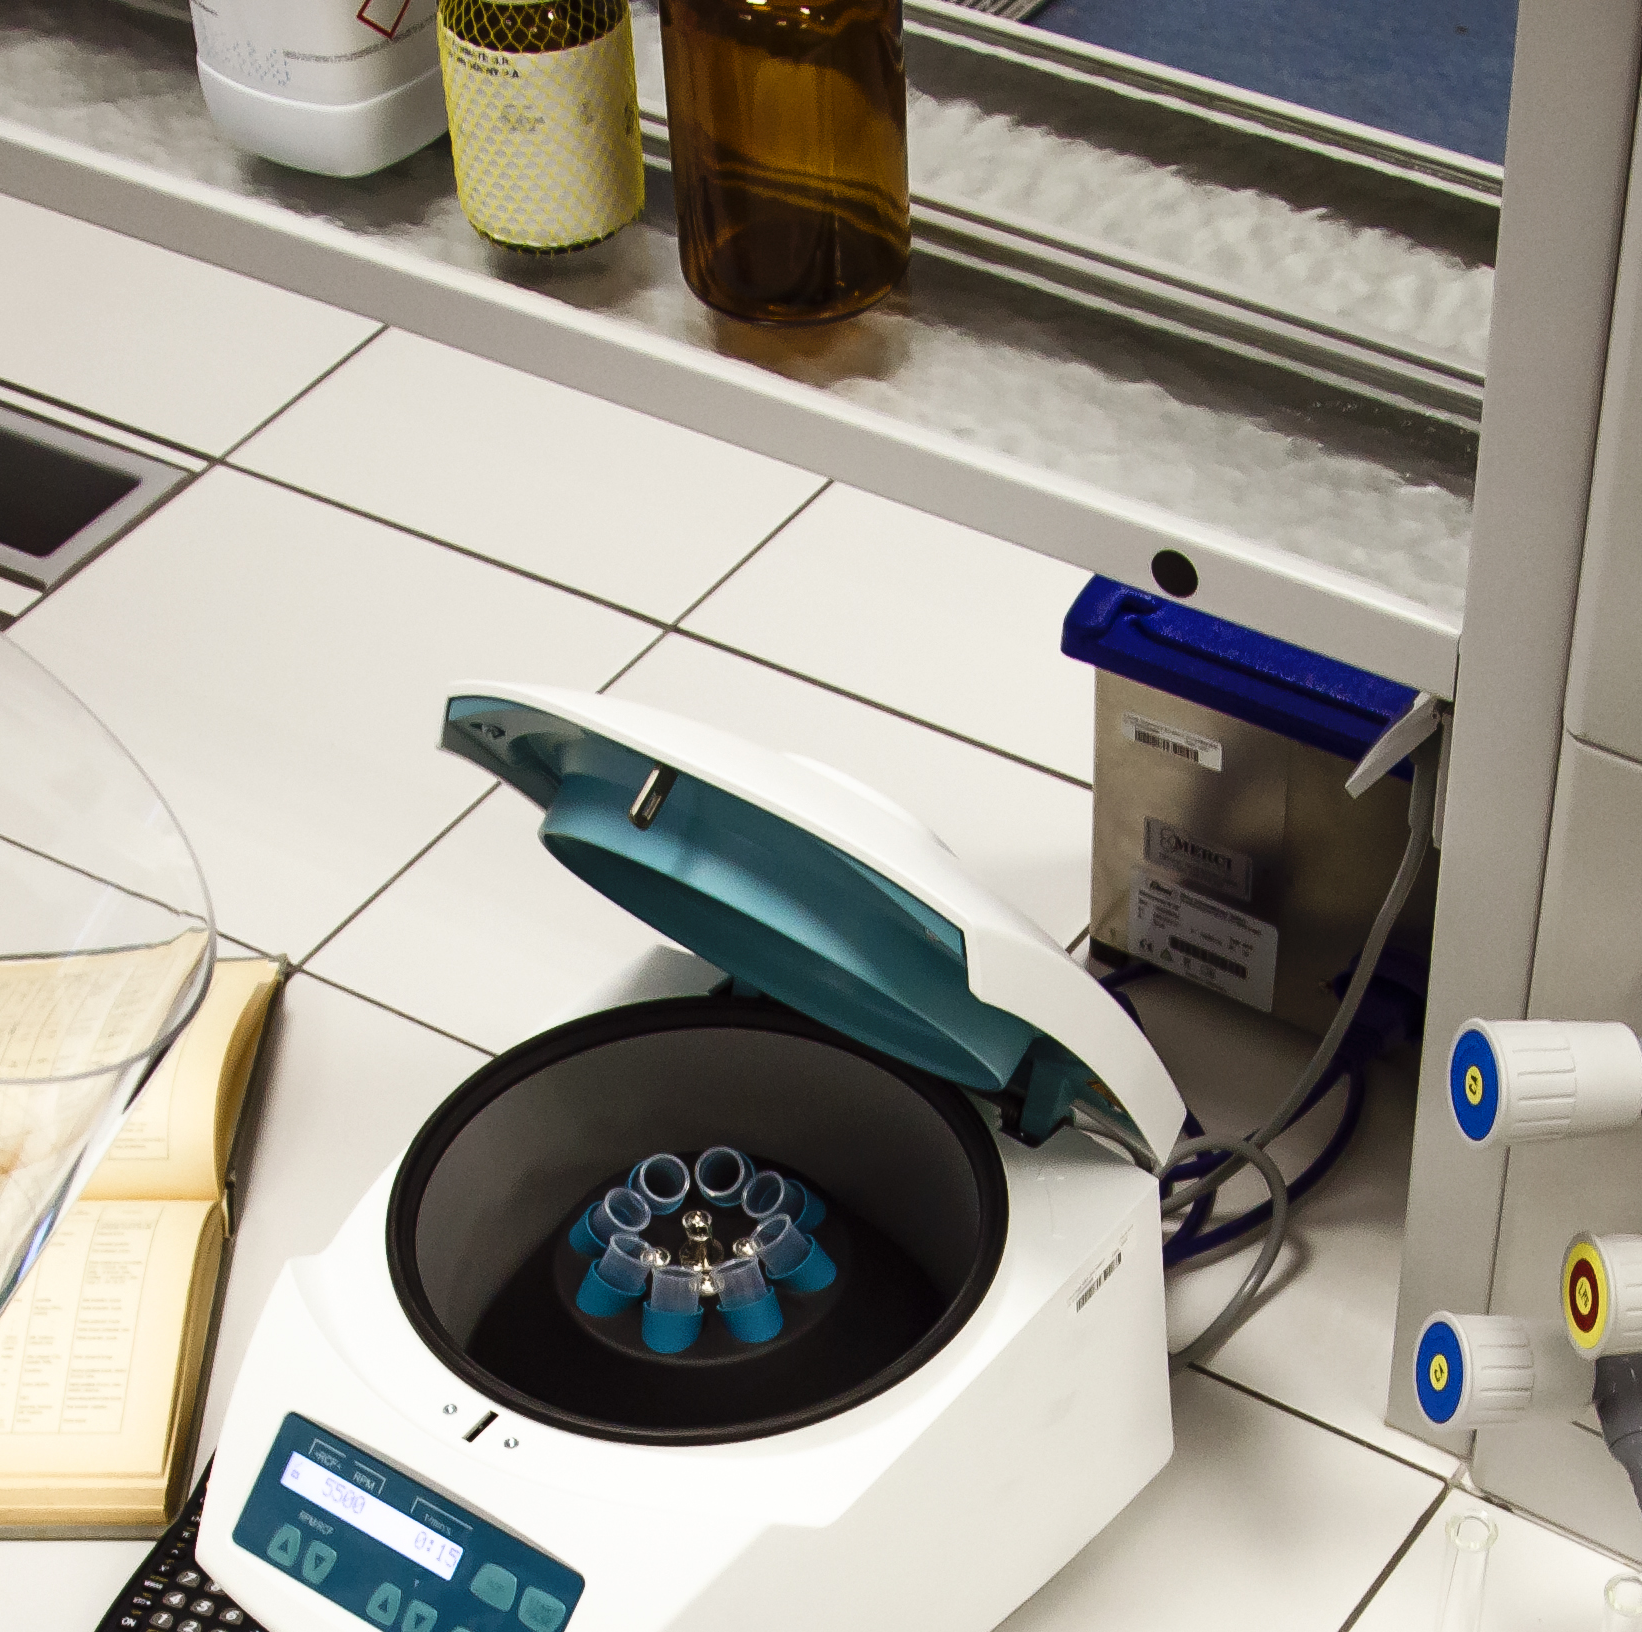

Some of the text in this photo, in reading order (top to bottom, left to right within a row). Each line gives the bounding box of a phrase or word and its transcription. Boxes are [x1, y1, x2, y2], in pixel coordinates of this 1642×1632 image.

[352, 1470, 376, 1491] RPM
[319, 1476, 461, 1569] 5500 0:15
[121, 1616, 136, 1627] ON
